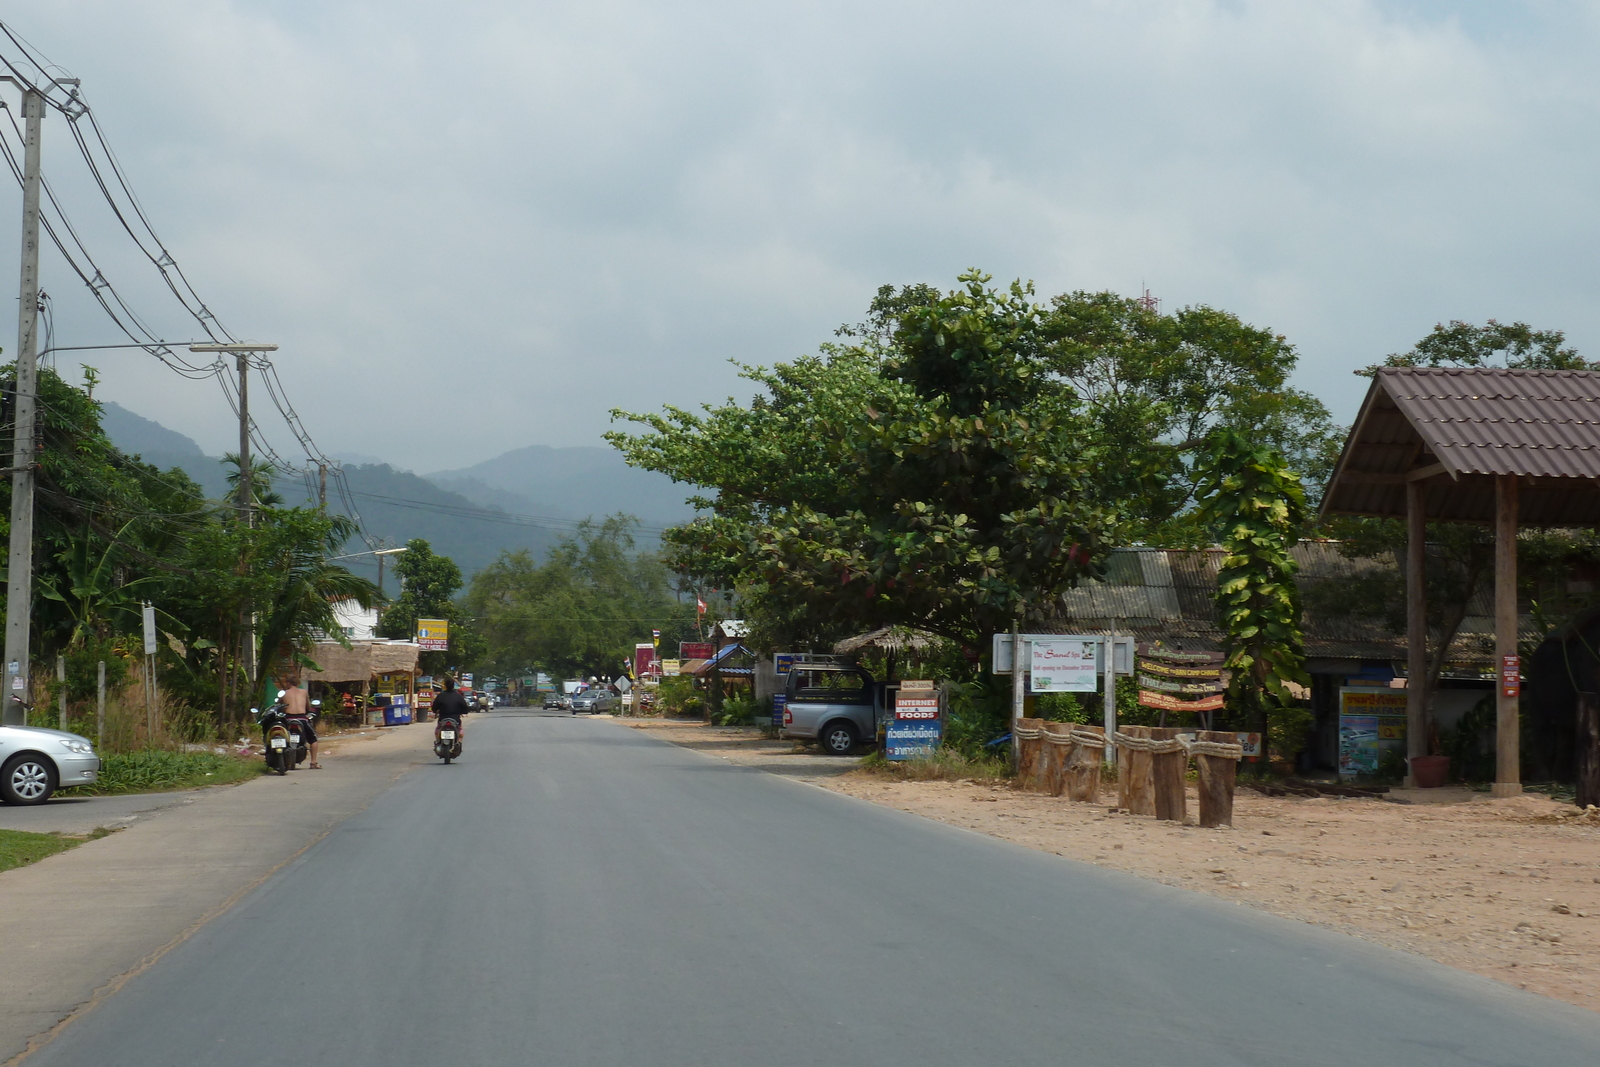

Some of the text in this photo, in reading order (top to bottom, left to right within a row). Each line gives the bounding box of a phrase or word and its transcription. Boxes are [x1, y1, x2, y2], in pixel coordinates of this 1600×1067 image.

[1141, 661, 1169, 674] WELCOME
[1142, 691, 1162, 699] THANK
[1347, 706, 1407, 715] BREAKFAST
